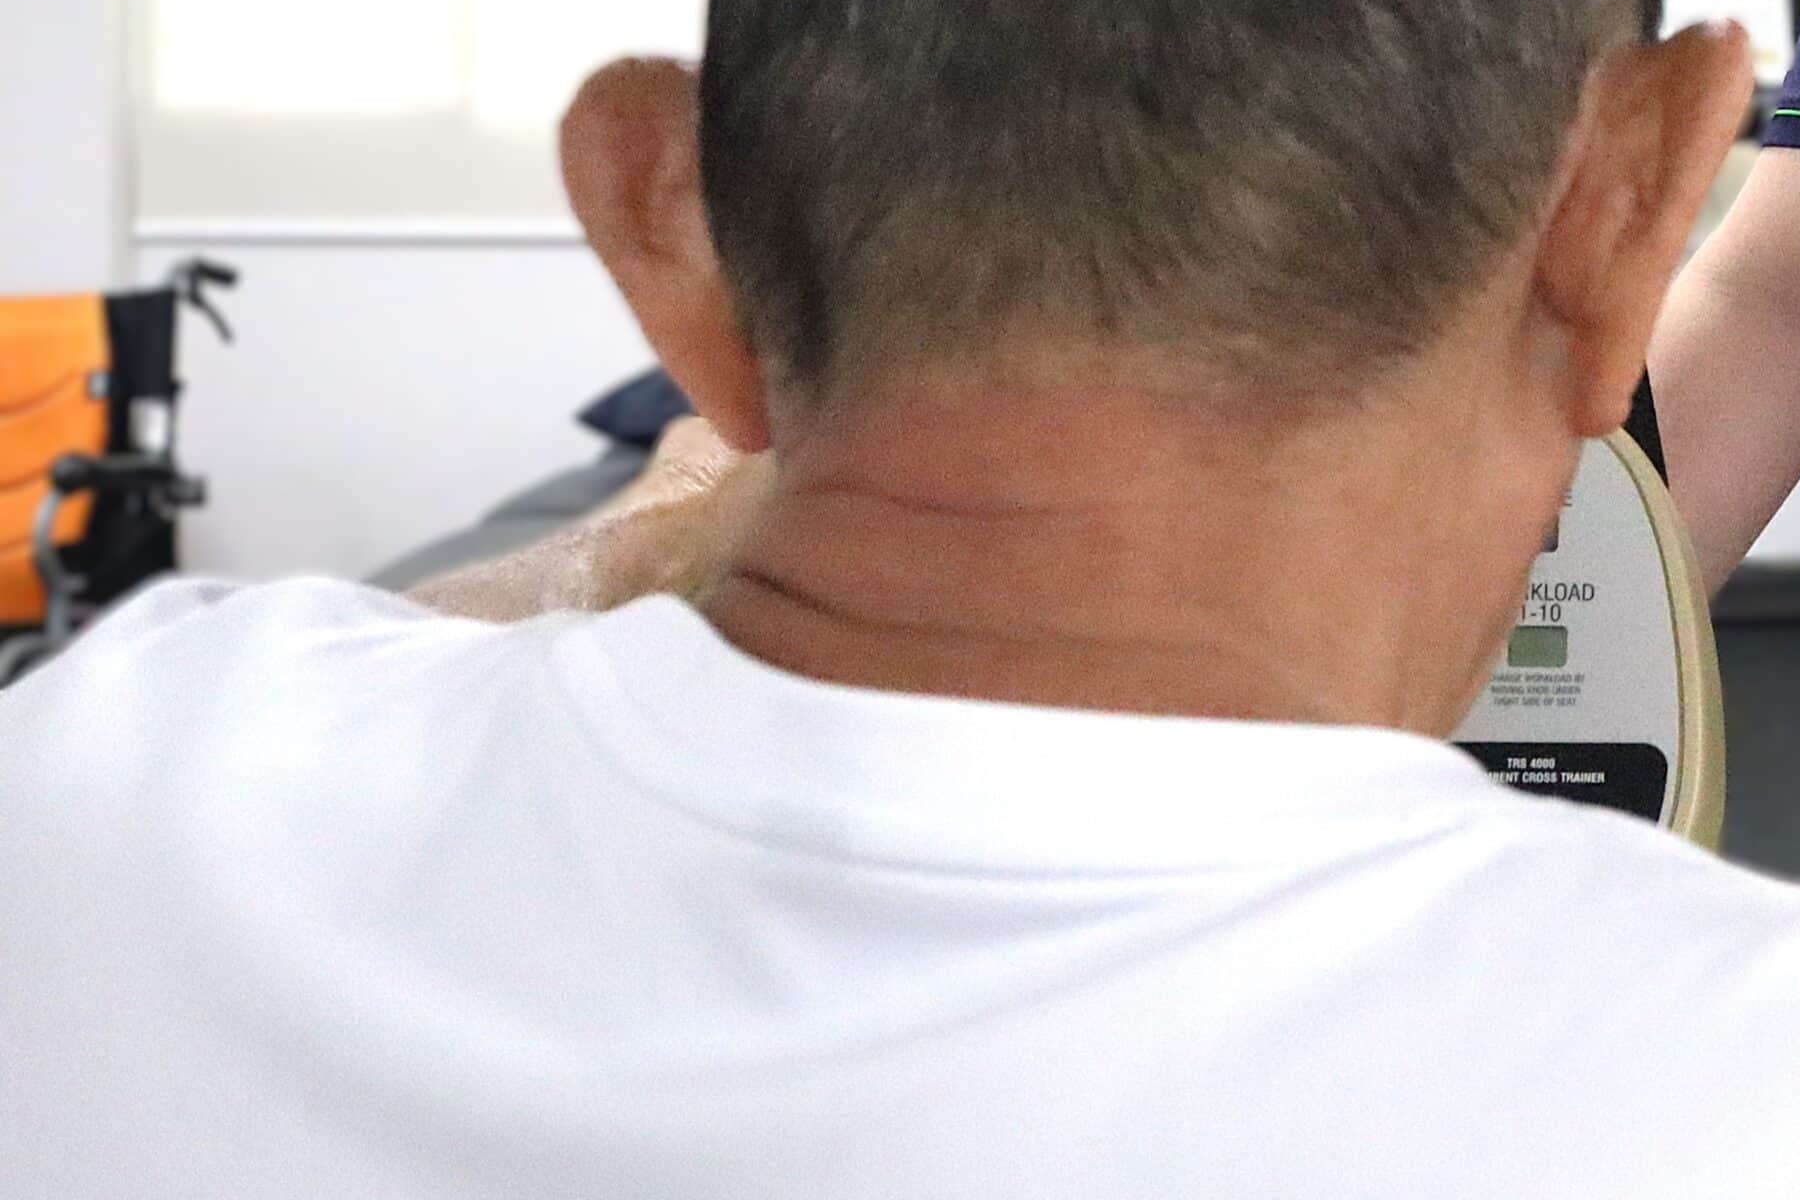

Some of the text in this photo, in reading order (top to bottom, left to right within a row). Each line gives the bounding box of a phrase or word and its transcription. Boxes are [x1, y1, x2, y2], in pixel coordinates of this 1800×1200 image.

[1525, 582, 1595, 602] KLOAD
[1507, 757, 1556, 769] TRS 4000
[1522, 771, 1558, 783] CROSS
[1561, 771, 1605, 783] TRAINER
